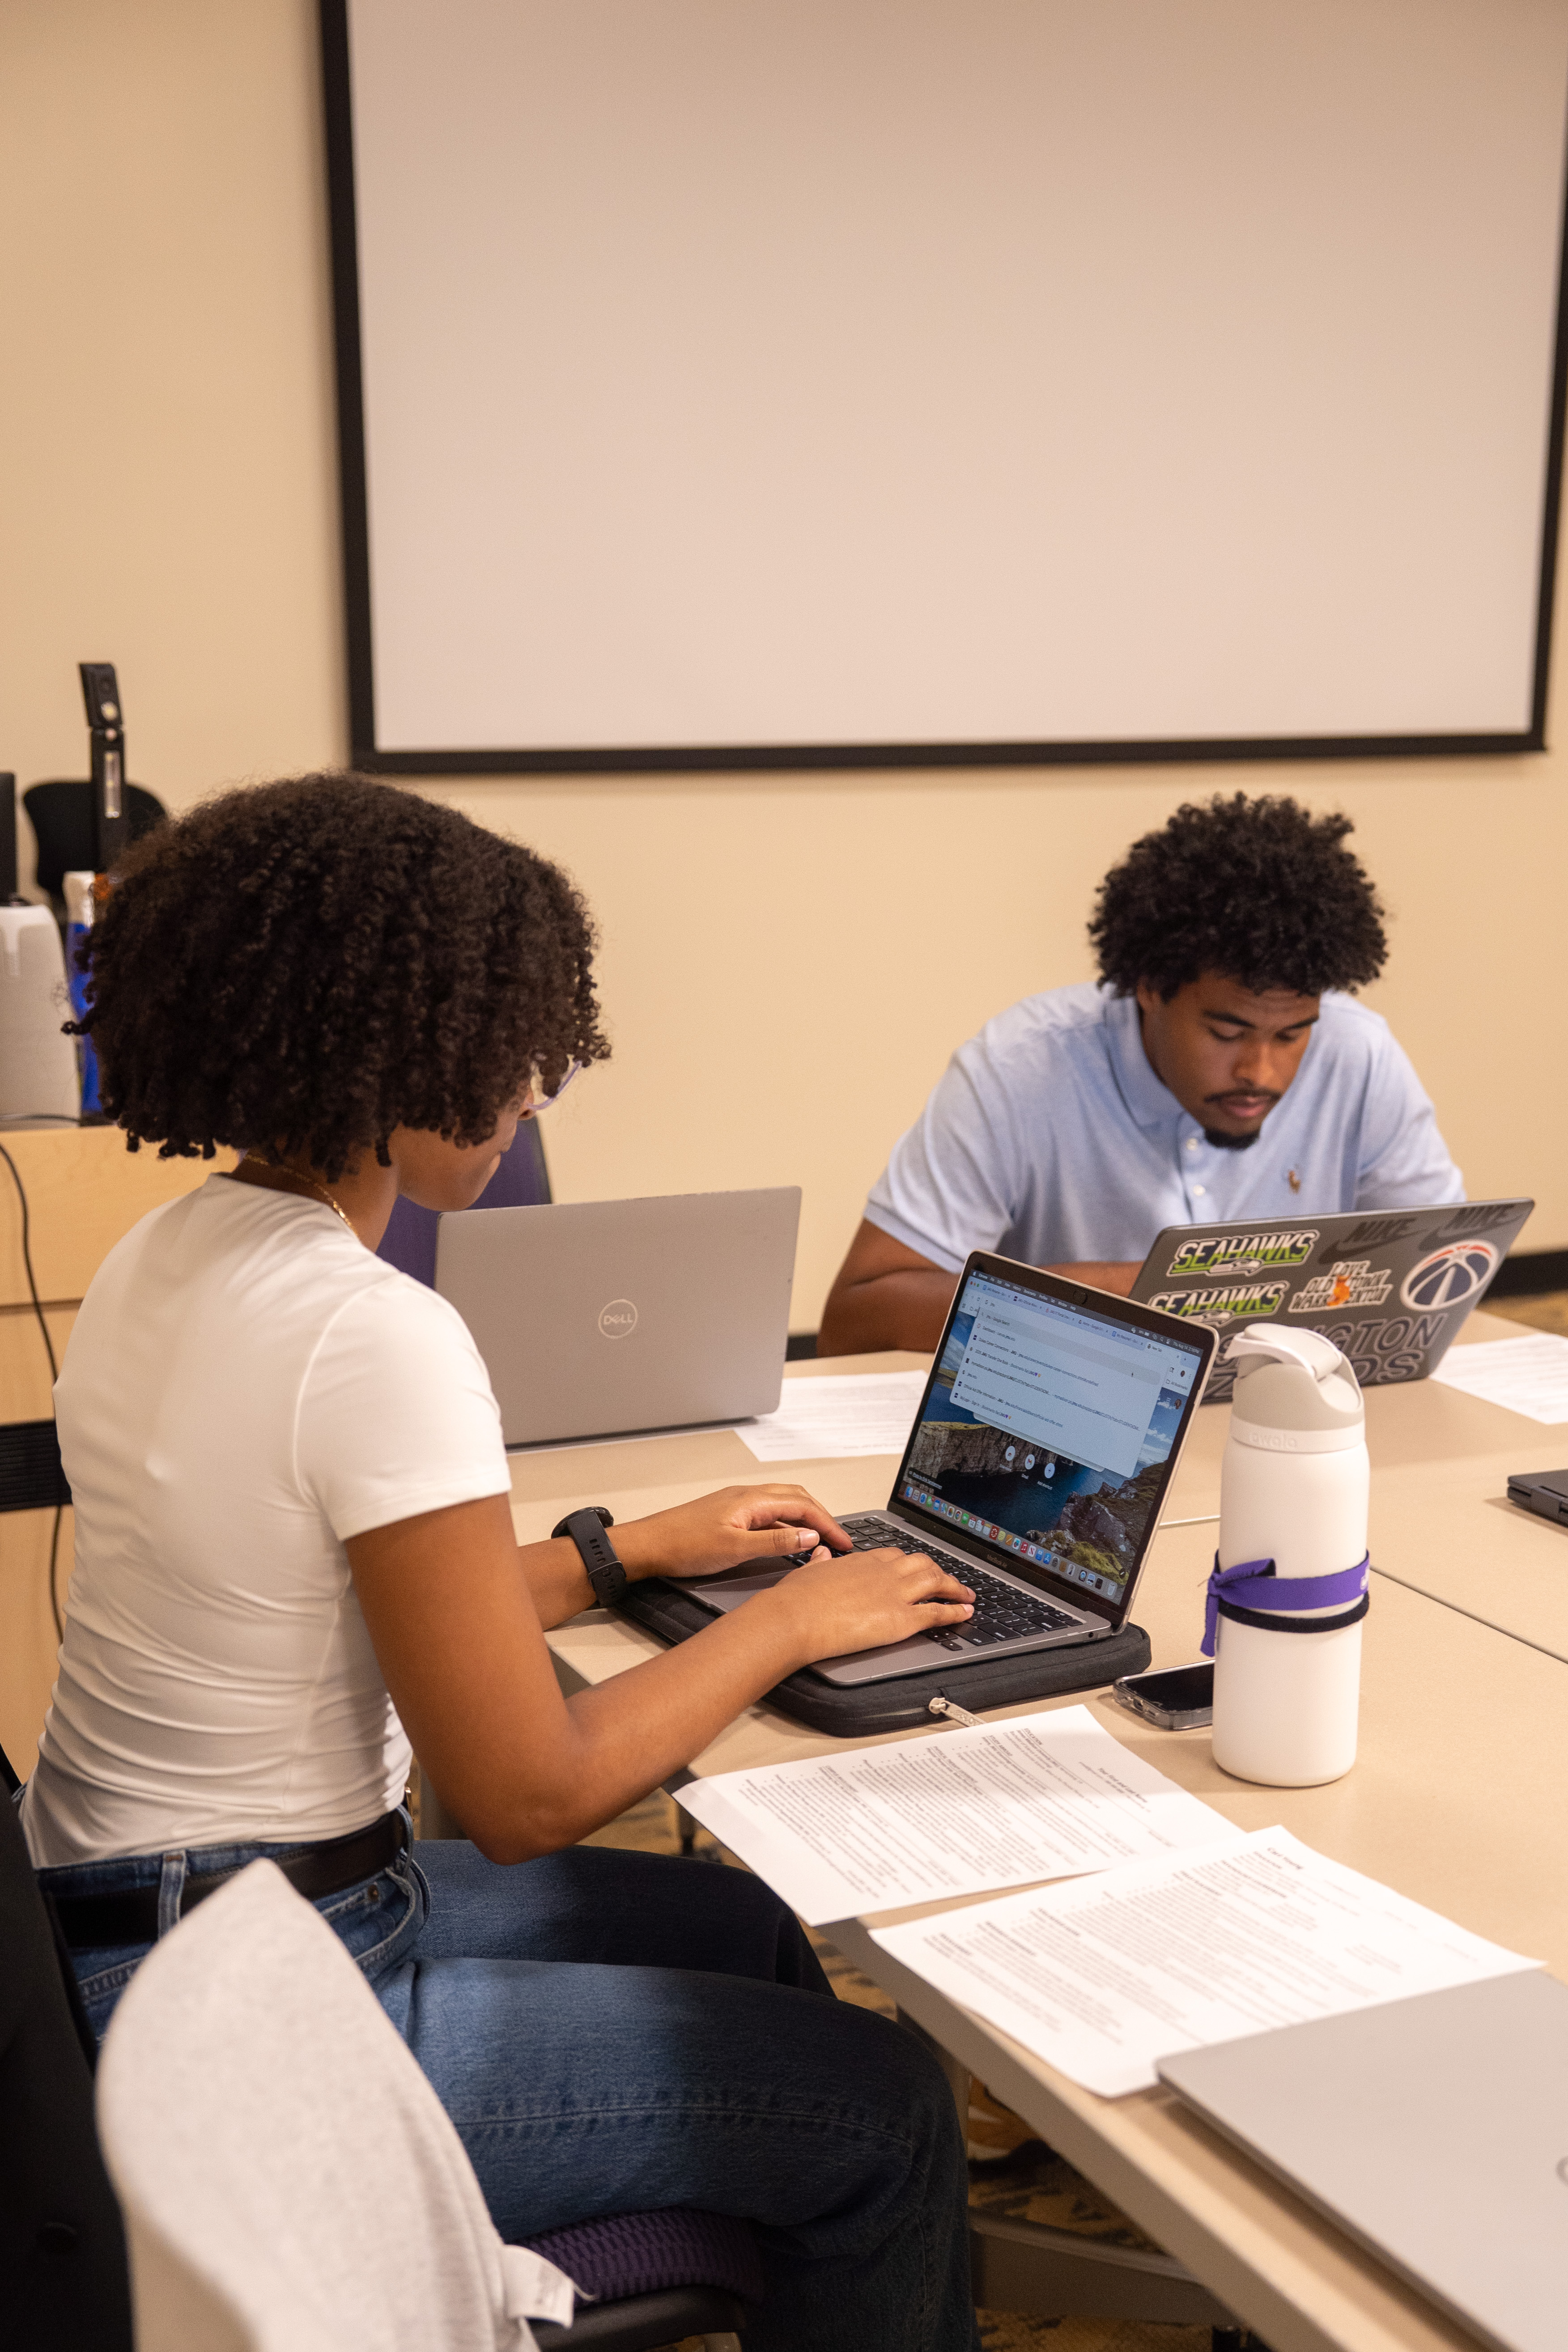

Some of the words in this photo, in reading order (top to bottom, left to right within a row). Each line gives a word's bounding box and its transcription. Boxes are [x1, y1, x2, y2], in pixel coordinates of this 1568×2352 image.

[1445, 1203, 1515, 1229] NIKE
[1343, 1218, 1417, 1243] NIKE
[1173, 1232, 1317, 1269] SEAHAWKS
